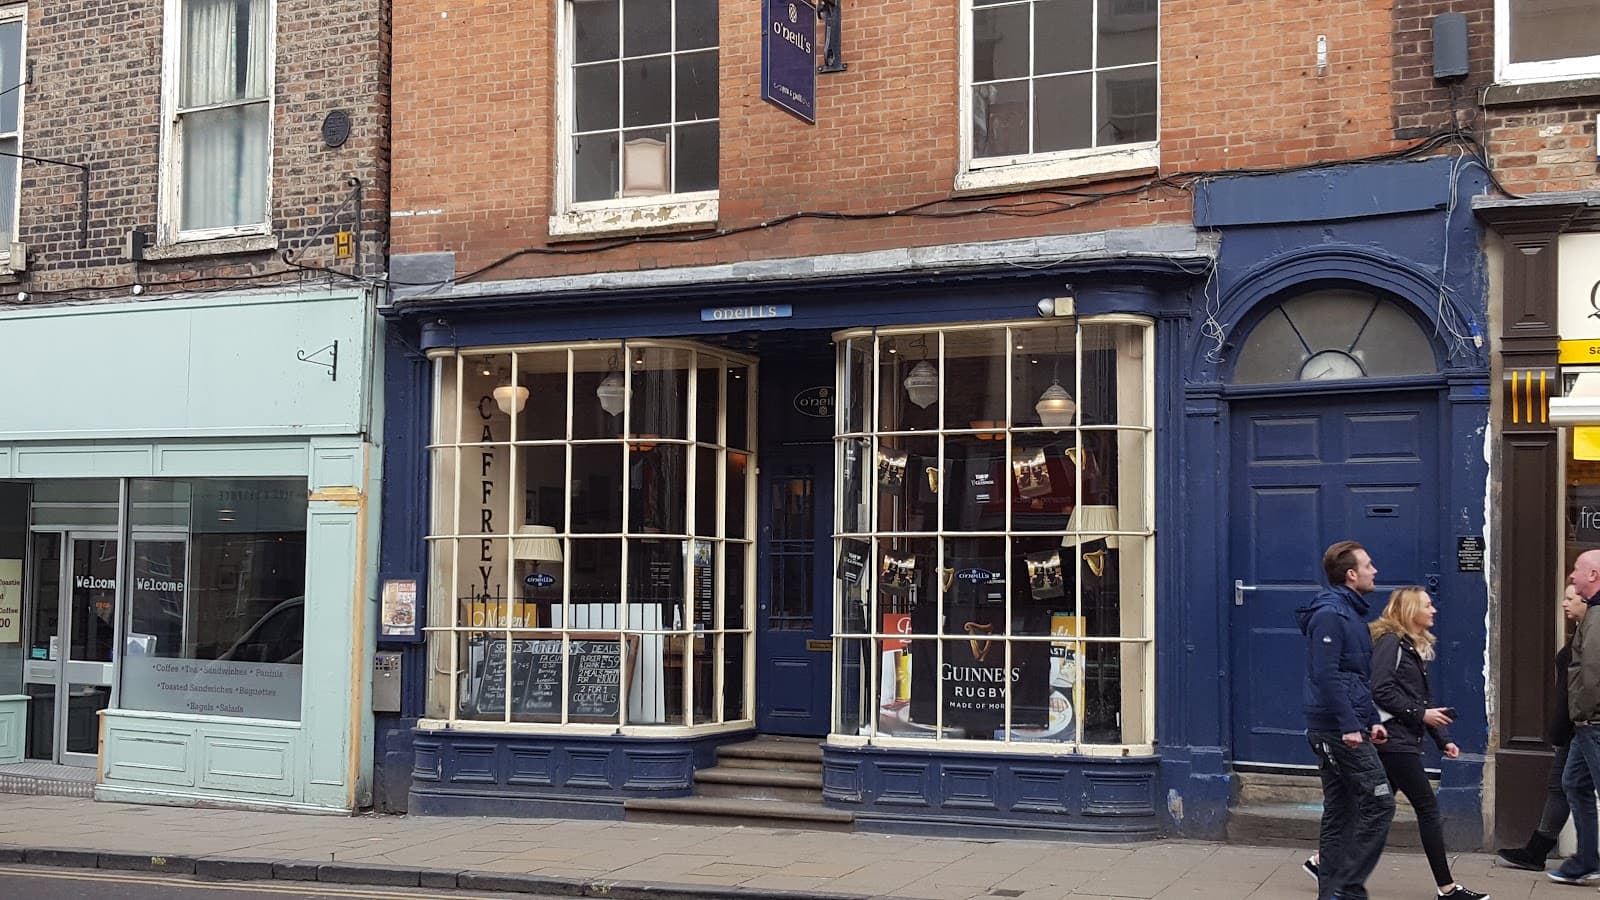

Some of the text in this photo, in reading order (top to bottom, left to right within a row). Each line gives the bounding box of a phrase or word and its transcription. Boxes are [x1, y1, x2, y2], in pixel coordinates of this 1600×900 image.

[76, 576, 116, 589] Welcom
[136, 578, 184, 591] Welcome
[591, 645, 620, 654] DEALS
[156, 664, 179, 673] Coffee
[185, 665, 198, 673] Tea
[942, 663, 1020, 682] GUINNES
[190, 684, 233, 694] Sandwiches
[955, 686, 1006, 698] RUGBY
[573, 693, 617, 703] COCKTAILS
[949, 701, 972, 709] MADE
